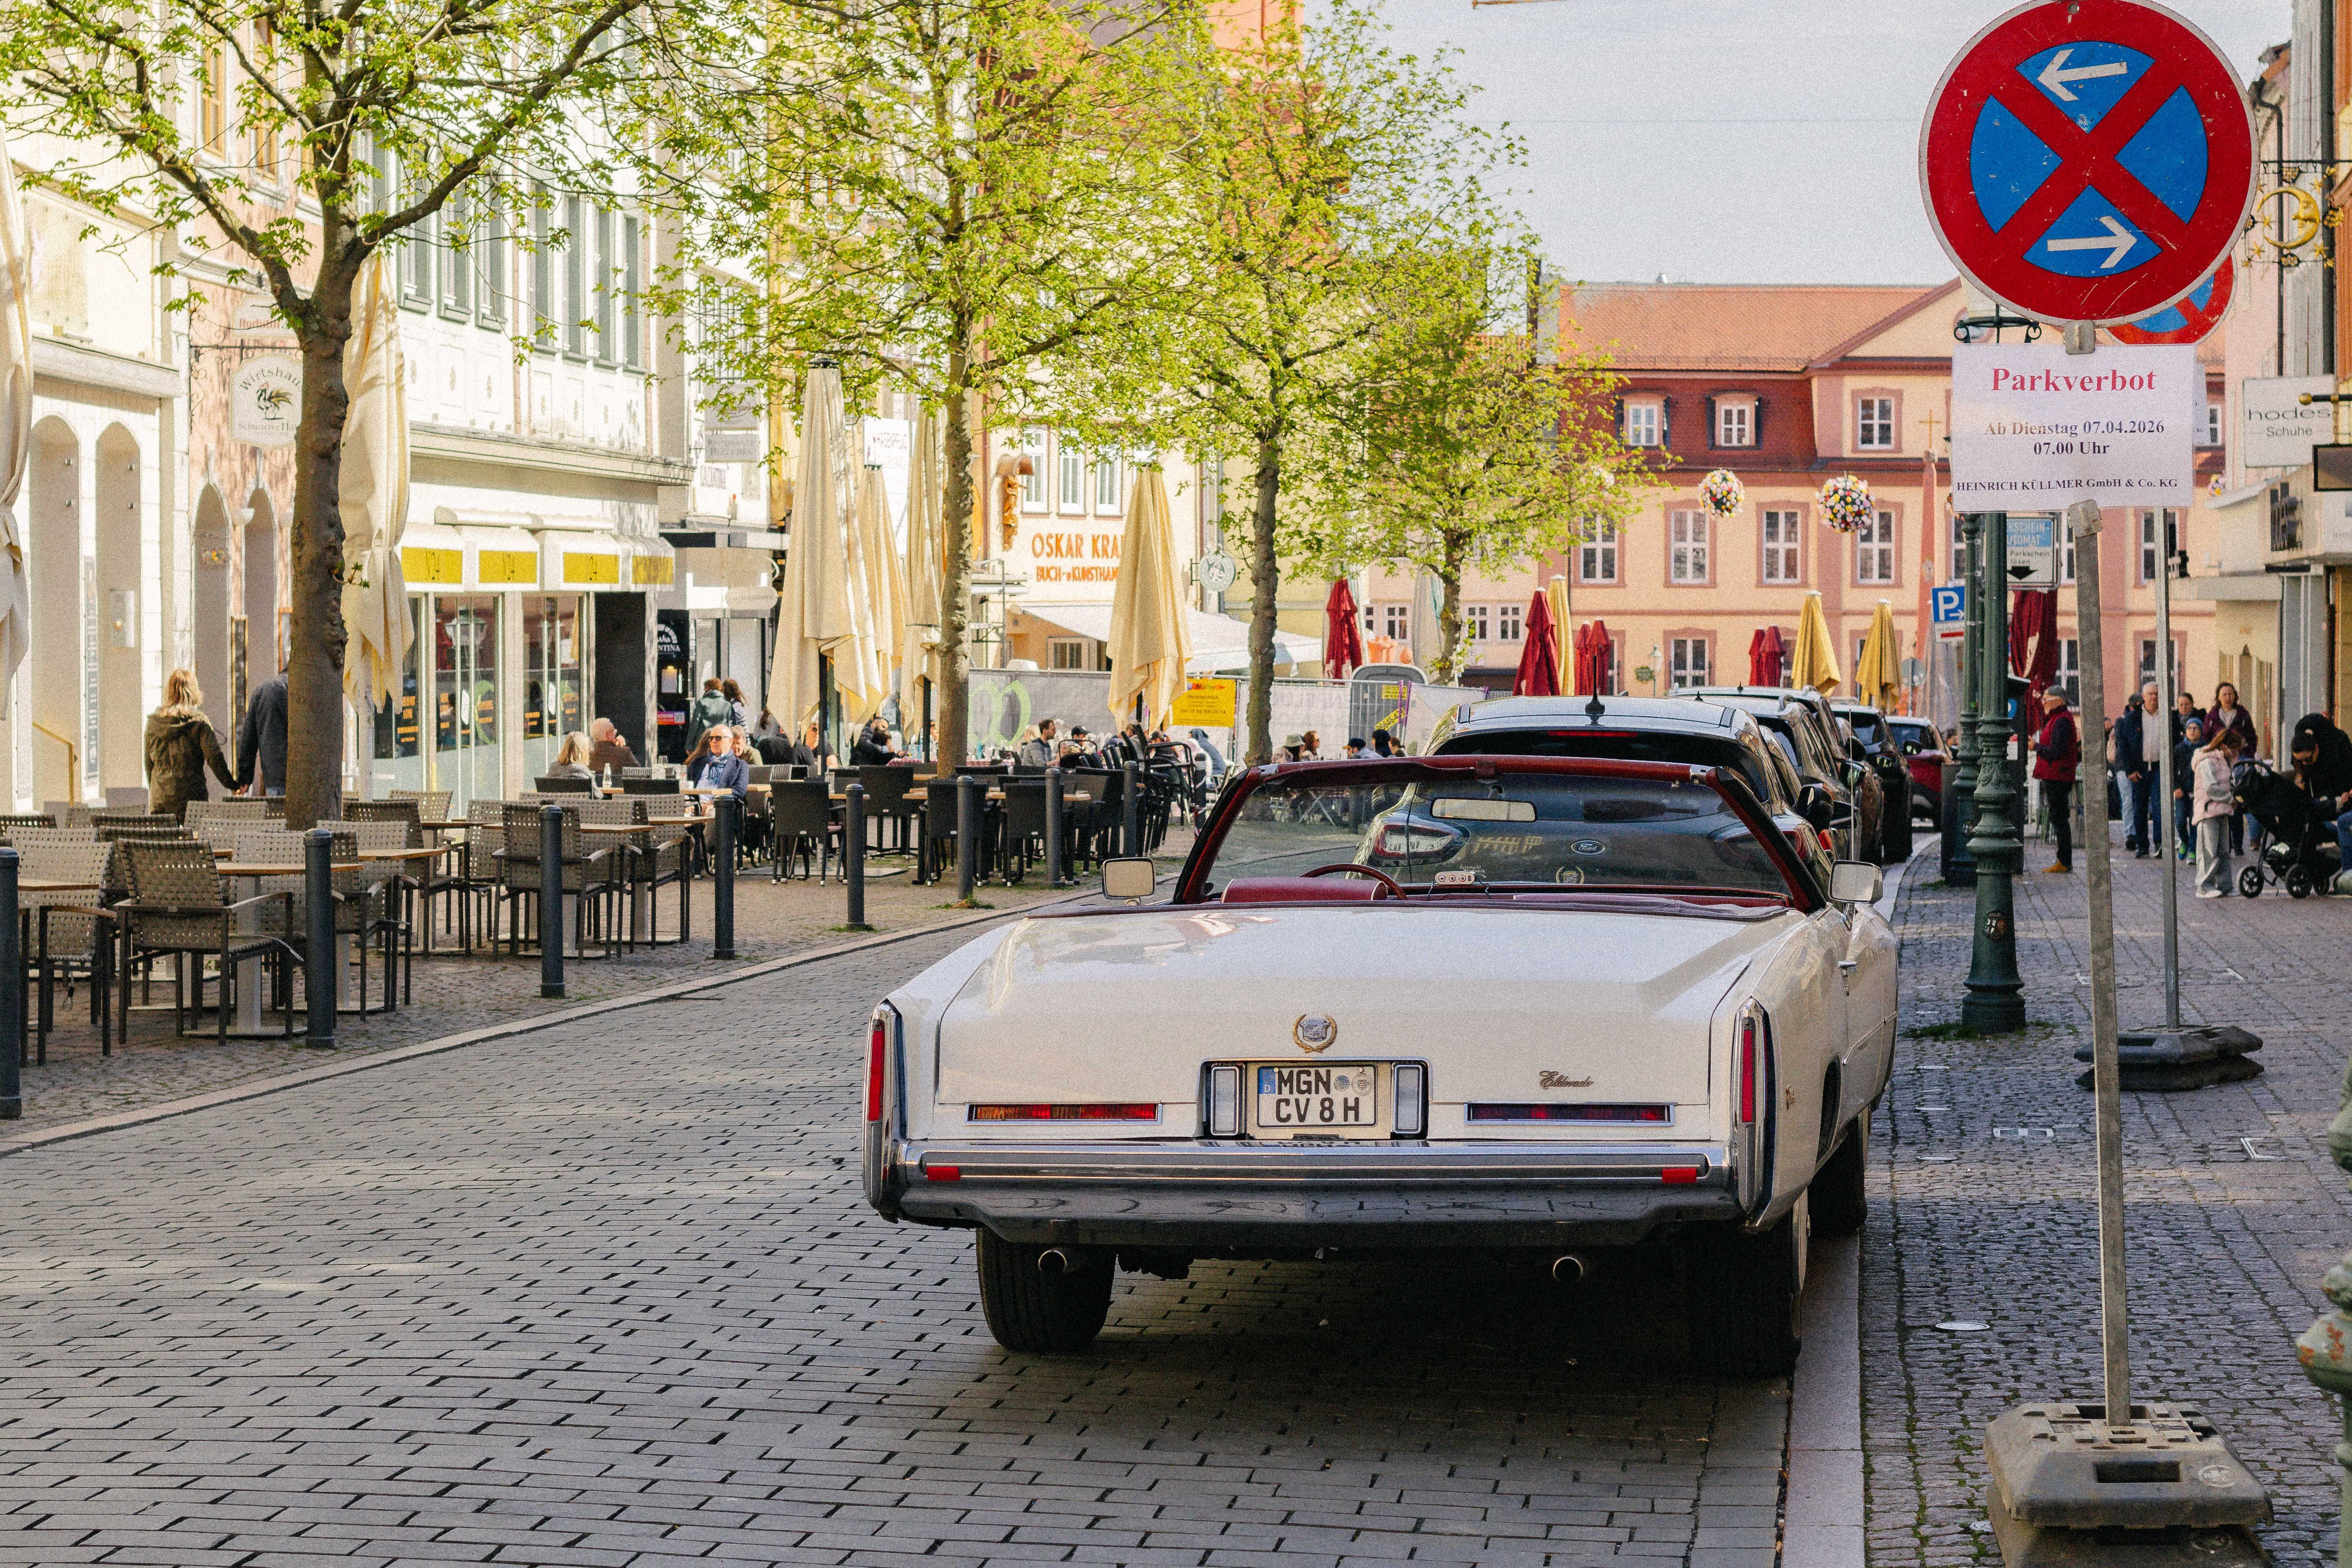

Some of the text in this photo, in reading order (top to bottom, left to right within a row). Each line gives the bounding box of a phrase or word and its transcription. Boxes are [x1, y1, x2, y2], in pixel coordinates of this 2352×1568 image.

[240, 367, 302, 390] Wirtshau
[1992, 368, 2157, 392] Parkverbot
[2249, 407, 2331, 421] hodes
[1984, 420, 2165, 438] Ab Dienstag 07.04.2026
[2266, 425, 2313, 437] Schuhe
[2033, 441, 2110, 455] 07.00 Uhr
[1957, 479, 2178, 491] HEINRICH KÜLLMER GmbH & Co. KG
[1032, 533, 1084, 559] OSKAR
[1938, 590, 1959, 621] P
[1578, 843, 1597, 851] Ford
[1277, 1069, 1331, 1095] MGN
[1539, 1070, 1594, 1090] Eldorado
[1276, 1098, 1310, 1123] CV
